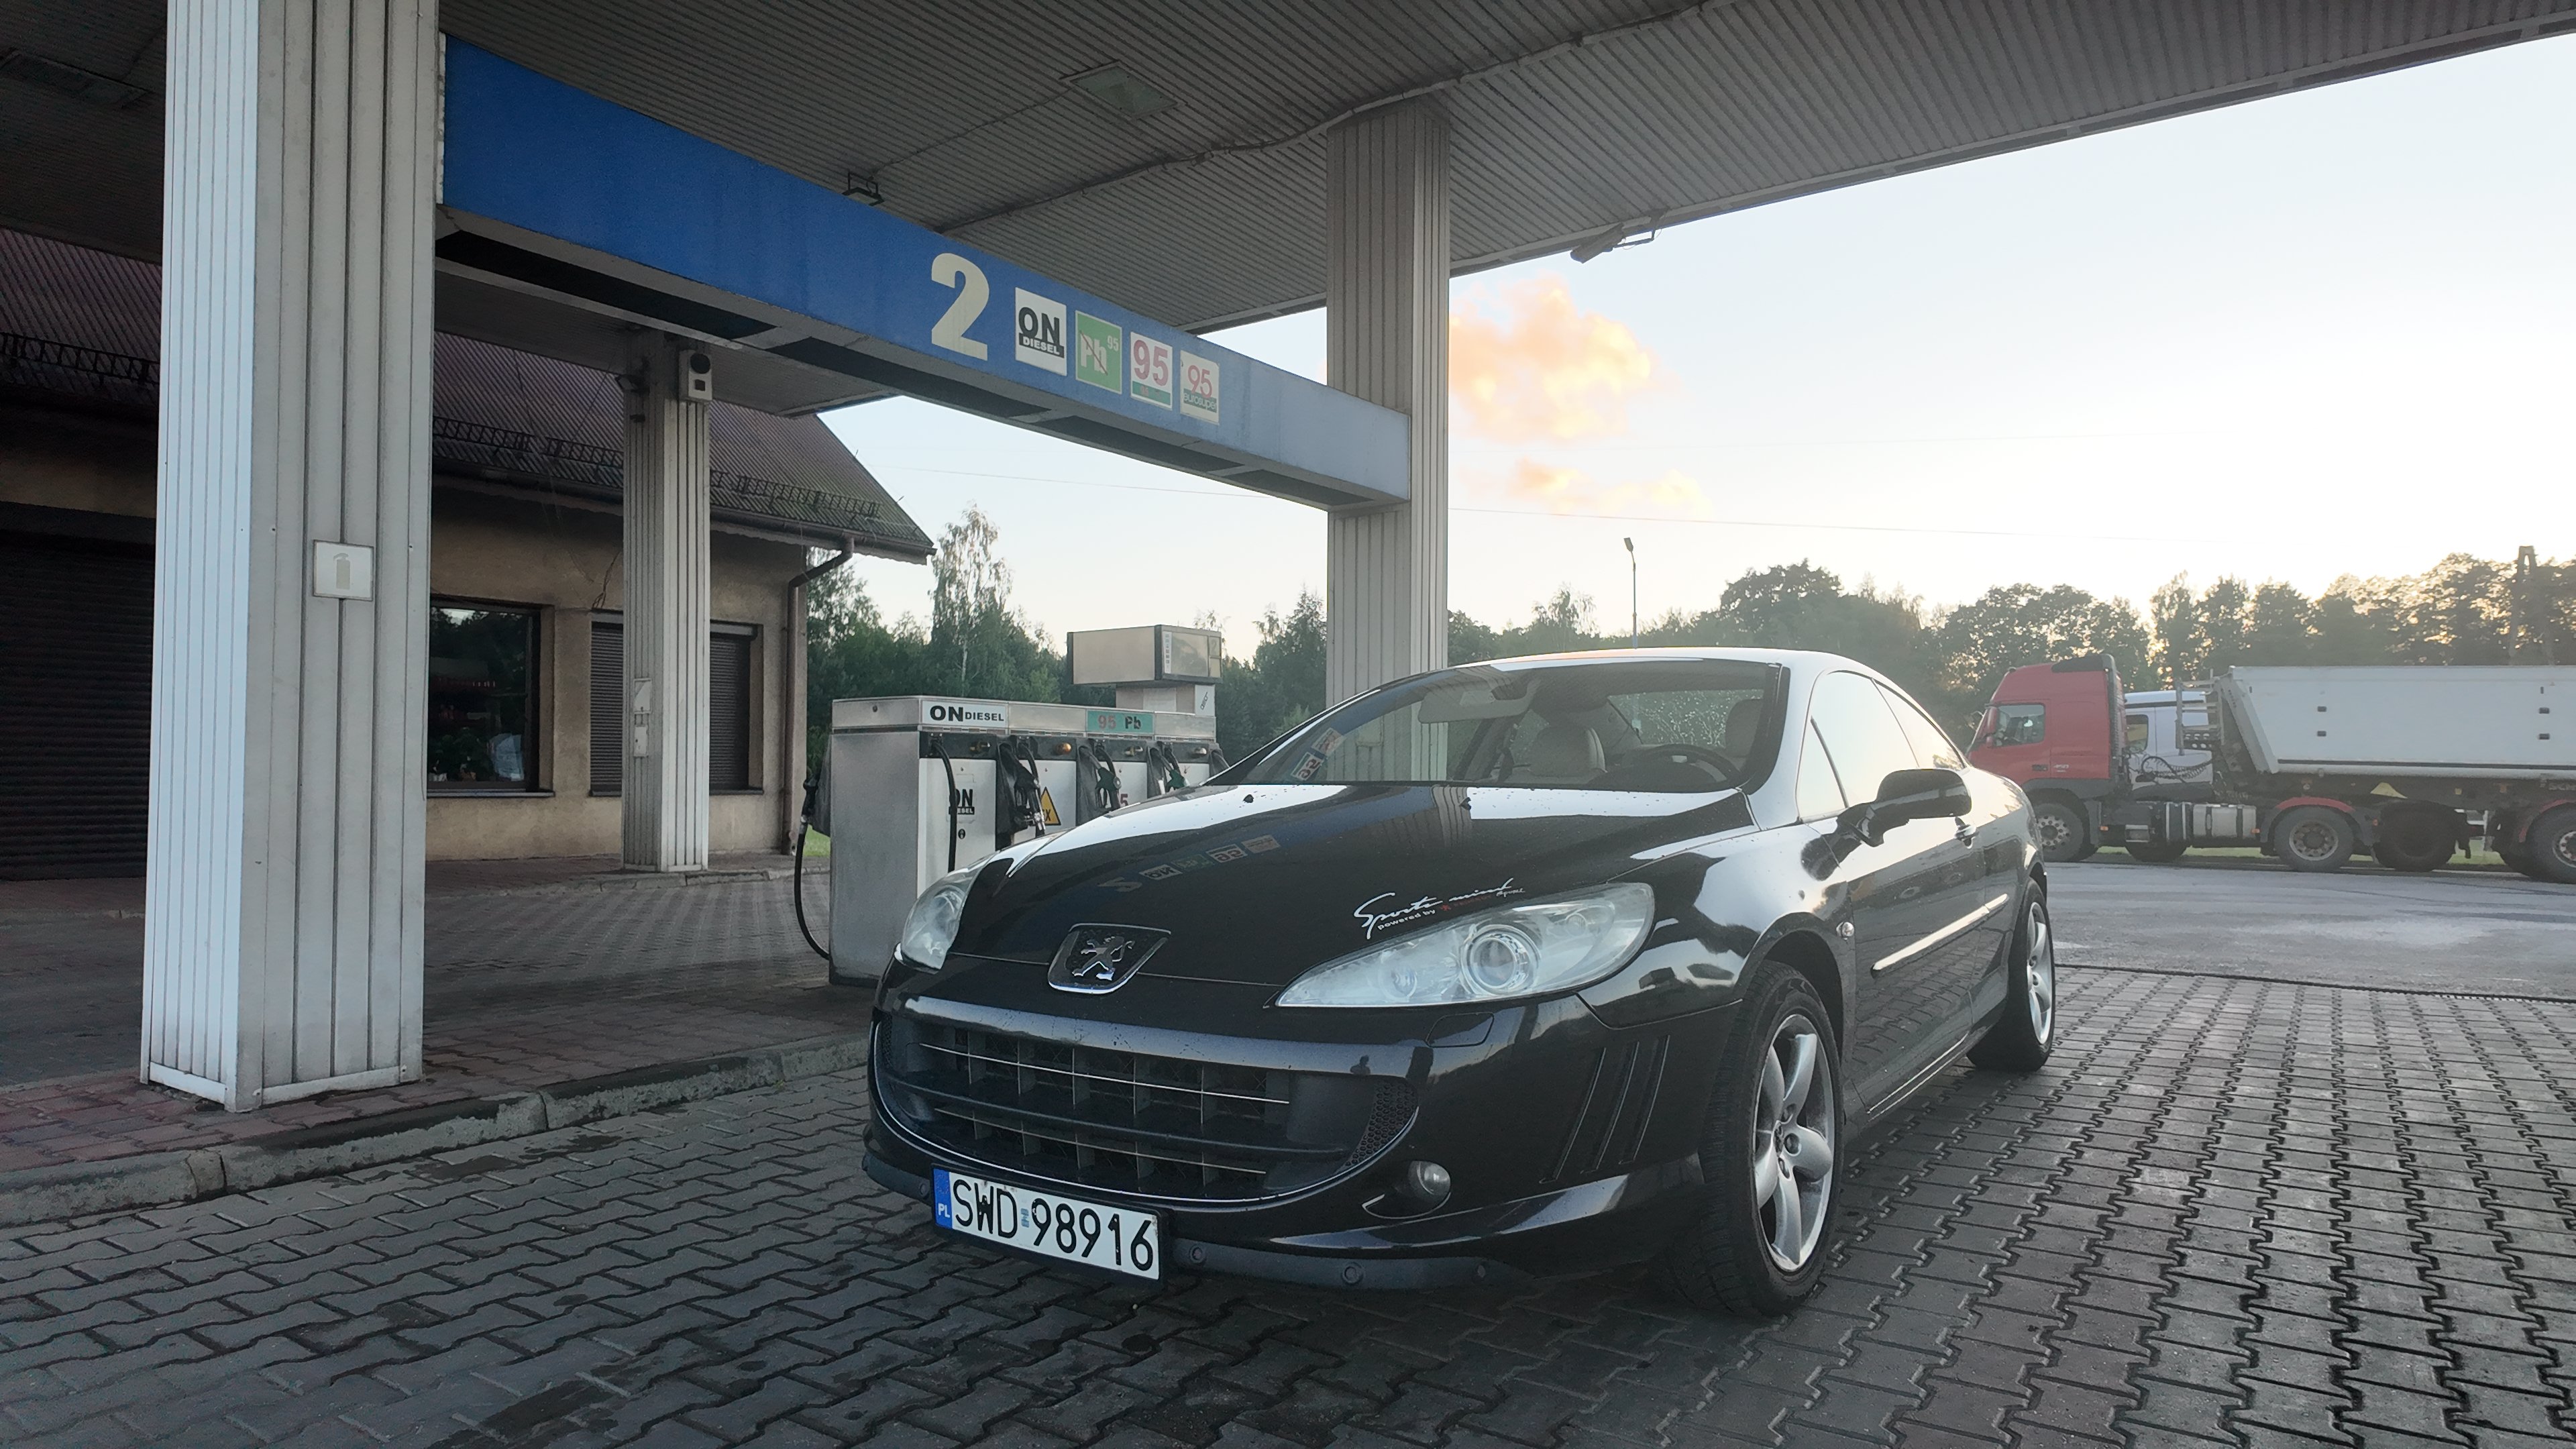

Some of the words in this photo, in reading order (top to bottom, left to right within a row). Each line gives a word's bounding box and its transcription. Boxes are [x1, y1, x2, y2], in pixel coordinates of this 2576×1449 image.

[931, 253, 989, 361] 2
[1018, 307, 1060, 346] ON
[1022, 336, 1060, 356] DIESEL
[1107, 335, 1119, 352] 95
[1133, 339, 1169, 386] 95
[1187, 364, 1212, 398] 95
[930, 705, 963, 722] ON
[965, 712, 1004, 722] DIESEL
[1097, 714, 1116, 730] 95
[1125, 716, 1141, 729] Pb
[1377, 912, 1421, 930] powered
[938, 1203, 951, 1218] PL
[953, 1179, 1018, 1239] SWD
[1031, 1197, 1154, 1271] 98916
